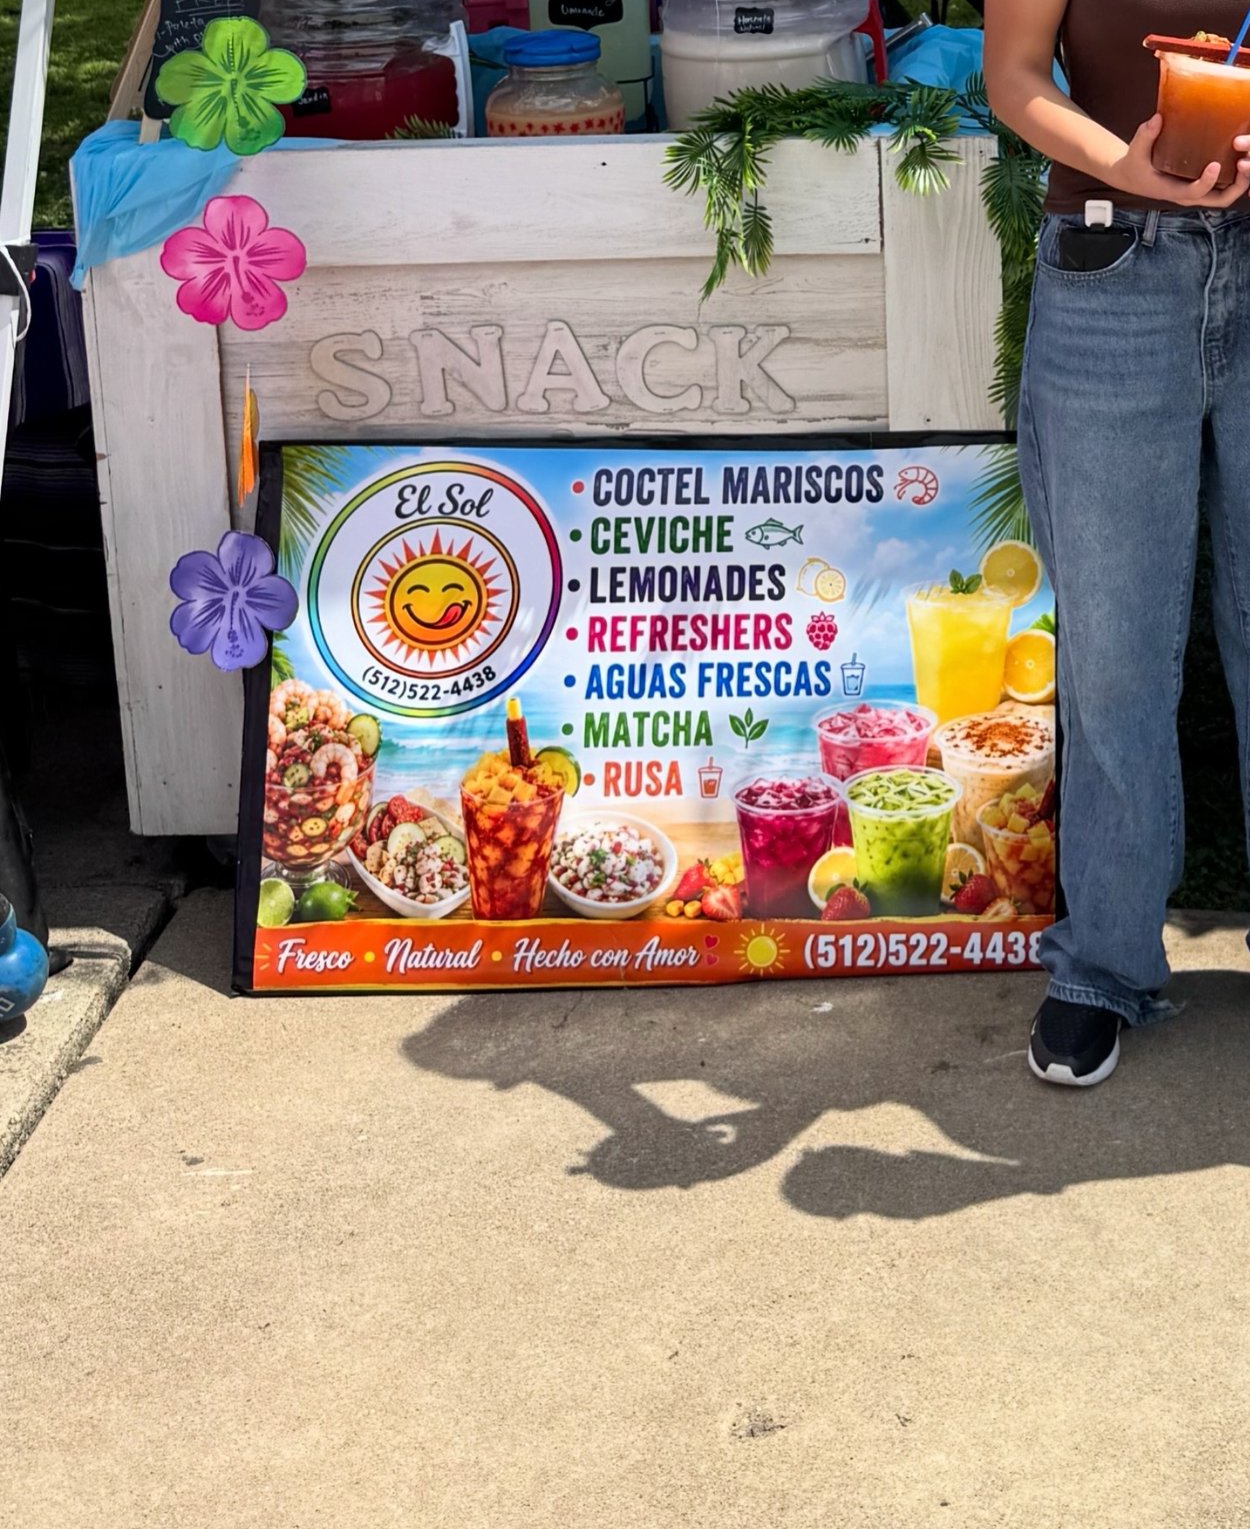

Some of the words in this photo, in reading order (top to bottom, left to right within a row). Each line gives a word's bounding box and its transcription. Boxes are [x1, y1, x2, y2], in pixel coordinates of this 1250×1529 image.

[310, 319, 796, 421] SNACK
[395, 484, 431, 519] El
[438, 483, 493, 518] Sol
[593, 467, 710, 507] COCTEL
[722, 464, 884, 504] MARISCOS
[590, 515, 734, 555] CEVICHE
[590, 564, 786, 604] LEMONADES
[588, 612, 793, 652] REFRESHERS
[362, 665, 496, 701] (512)522-4438
[585, 662, 686, 700] AGUAS
[697, 661, 831, 698] FRESCAS
[584, 710, 713, 748] MATCHA
[603, 760, 684, 798] RUSA
[277, 939, 354, 974] Fresco
[384, 939, 482, 975] Natural
[513, 937, 586, 972] Hecho
[589, 949, 632, 969] con
[634, 935, 700, 971] Amor
[804, 931, 1042, 969] (512)522-4438
